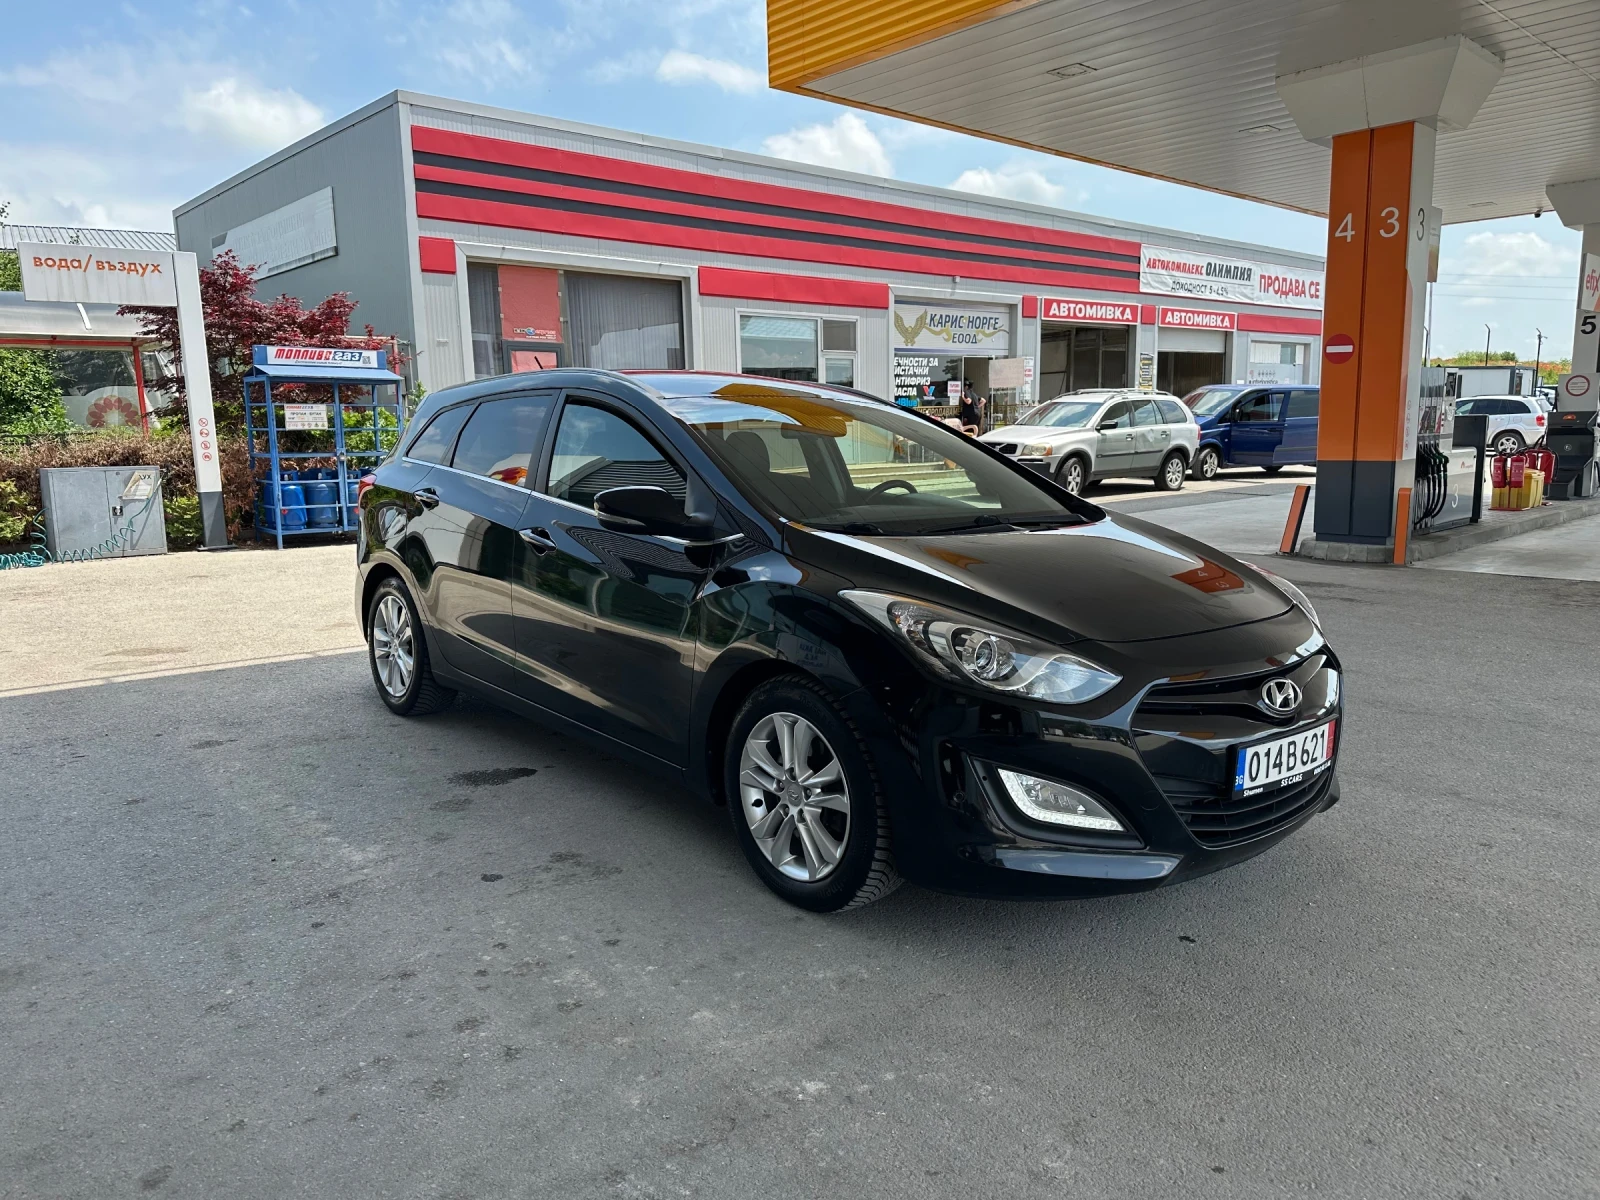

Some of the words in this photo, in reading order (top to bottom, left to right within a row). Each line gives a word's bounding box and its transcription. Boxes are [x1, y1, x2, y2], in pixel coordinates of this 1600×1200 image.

[1335, 213, 1355, 242] 4
[1379, 207, 1400, 238] 3
[1416, 208, 1425, 241] 3
[1146, 257, 1204, 276] АВТОКОМПЛЕКС
[1205, 262, 1252, 282] ОЛИМПИЯ
[1171, 281, 1207, 293] ДОХОДНОСТ
[1259, 274, 1306, 298] ПРОДАВА
[1308, 281, 1320, 299] СЕ
[1049, 302, 1133, 320] АВТОМИВКА
[1165, 311, 1231, 328] АВТОМИВКА
[929, 313, 964, 329] КАРИС
[966, 315, 999, 330] НОРГЕ
[1580, 315, 1597, 335] 5
[952, 332, 978, 344] ЕООД
[894, 357, 928, 366] ЕЧНОСТИ
[929, 358, 938, 367] ЗА
[894, 366, 929, 375] ИСТАЧКИ
[895, 377, 931, 386] НТИФРИЗ
[896, 398, 918, 407] dBlue
[1451, 483, 1459, 508] 3
[1243, 787, 1264, 797] Shumen
[1288, 773, 1303, 785] CARS
